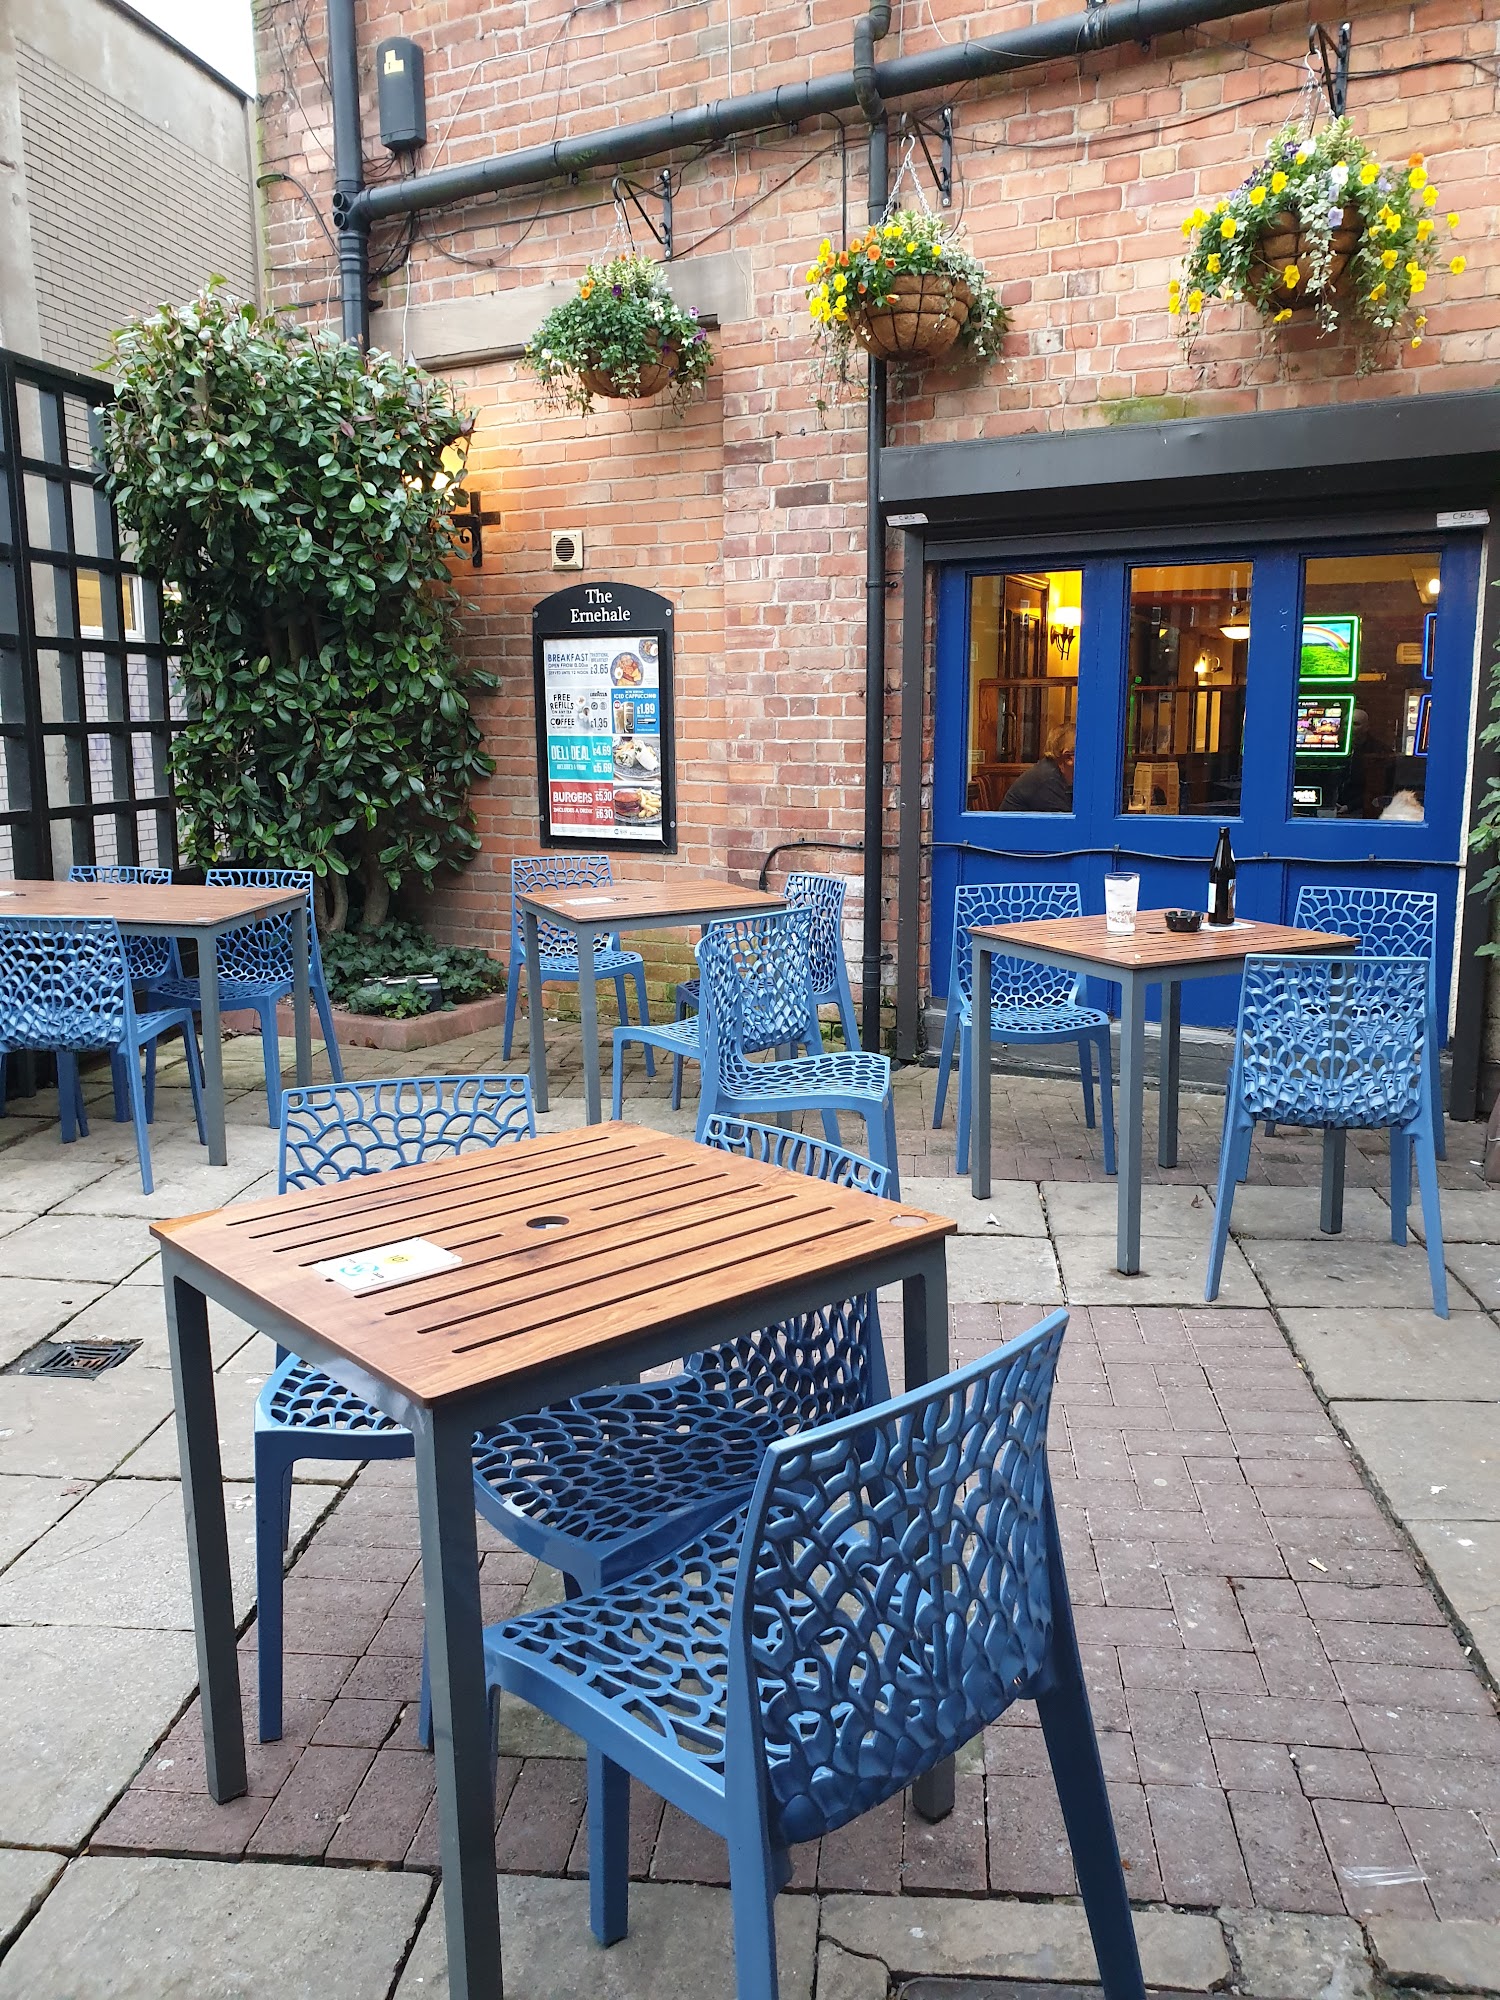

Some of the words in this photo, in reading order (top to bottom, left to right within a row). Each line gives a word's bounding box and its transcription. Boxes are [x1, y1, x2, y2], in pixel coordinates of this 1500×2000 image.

[585, 588, 613, 604] The
[570, 606, 631, 623] Ernehale
[547, 653, 588, 662] BREAKFAST
[590, 664, 609, 675] £3.65
[553, 693, 571, 702] FREE
[549, 701, 574, 710] REFILLS
[636, 703, 656, 715] £1.89
[550, 718, 575, 726] COFFEE
[590, 718, 608, 728] £1.35
[551, 745, 569, 760] DELI
[570, 745, 591, 761] DEAL
[593, 745, 611, 756] £4.69
[593, 763, 612, 773] £5.69
[553, 791, 593, 803] BURGERS
[595, 791, 612, 802] £5.30
[596, 808, 614, 819] £6.30
